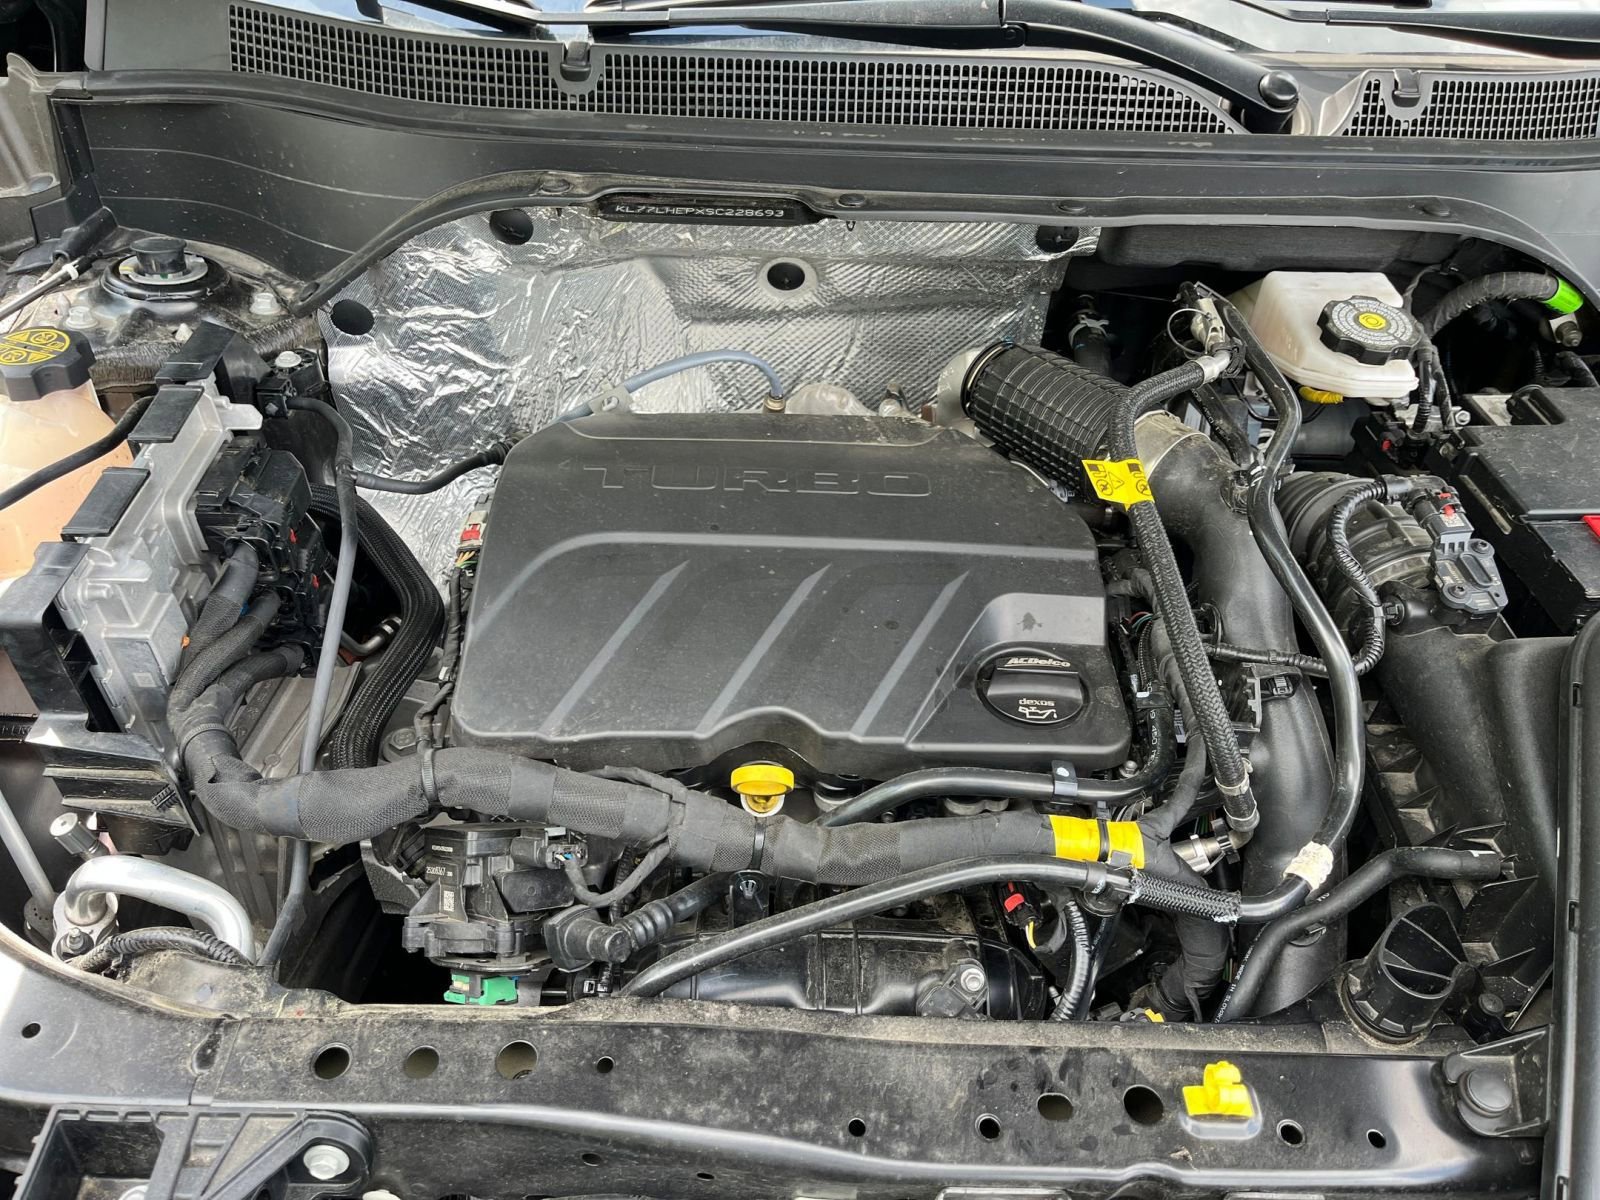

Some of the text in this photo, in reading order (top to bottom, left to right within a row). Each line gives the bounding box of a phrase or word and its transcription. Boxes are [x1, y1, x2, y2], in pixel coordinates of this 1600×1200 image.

[615, 204, 785, 218] KL77LHEPXSC228693
[583, 464, 932, 497] TURBO
[1005, 657, 1071, 668] ACDelco
[1018, 698, 1055, 707] dexos
